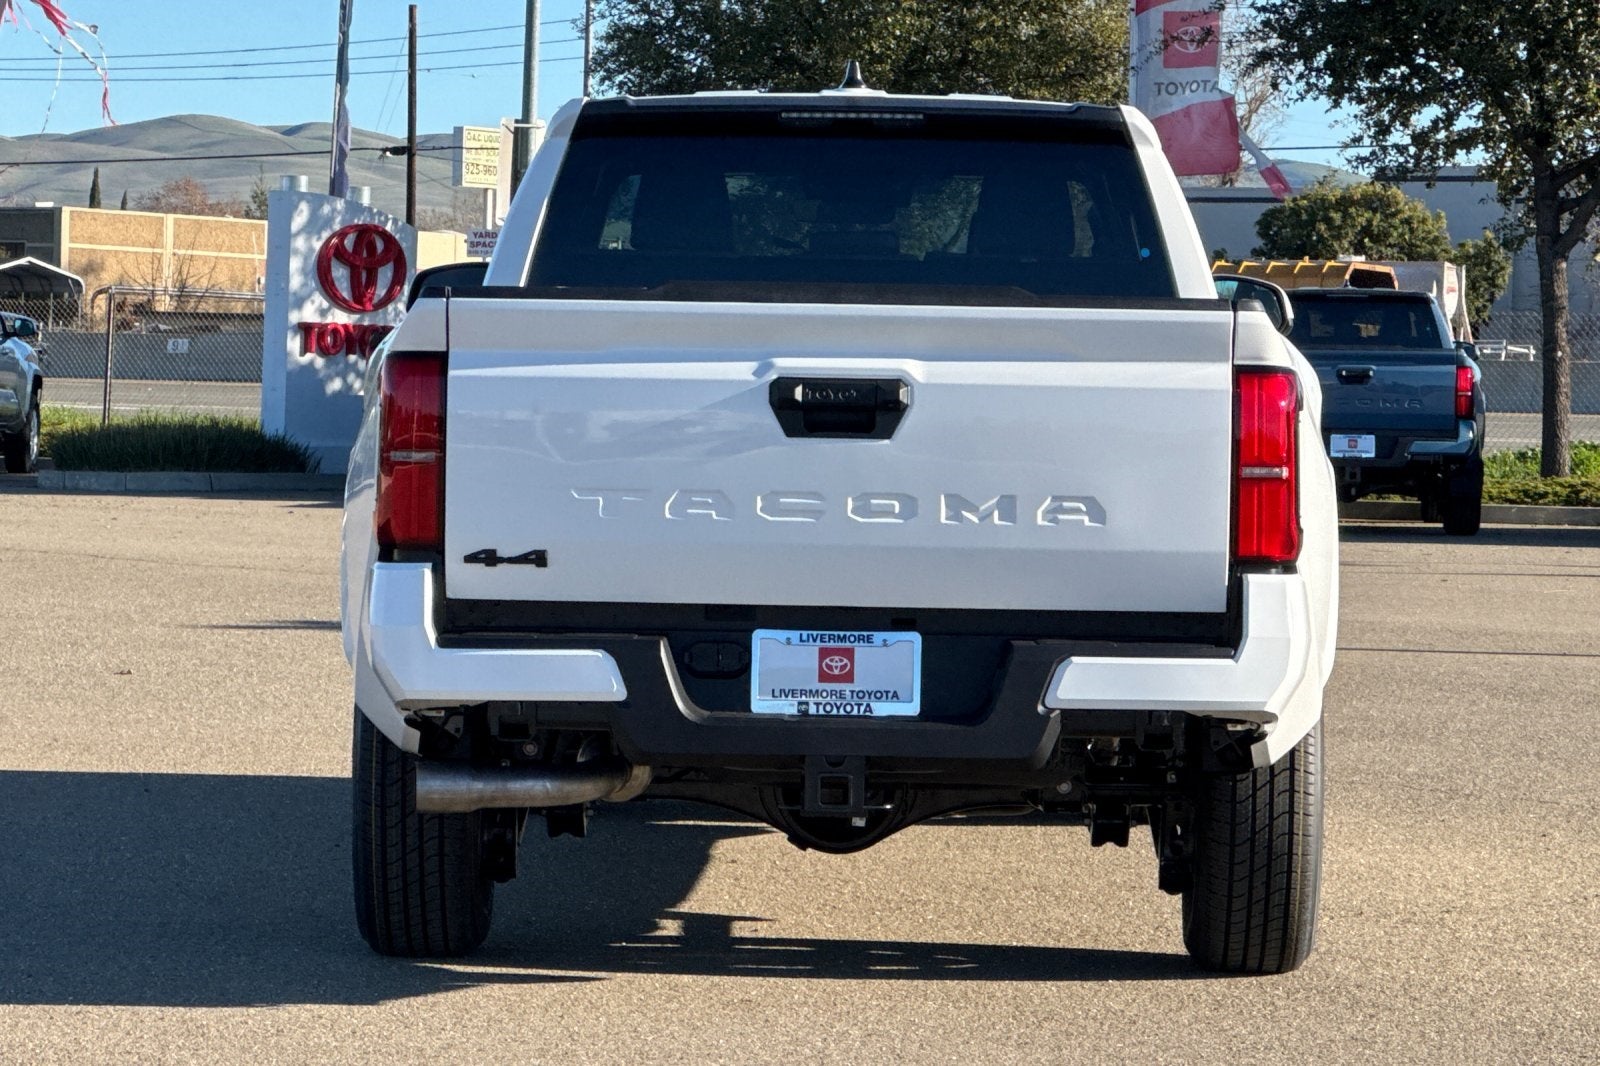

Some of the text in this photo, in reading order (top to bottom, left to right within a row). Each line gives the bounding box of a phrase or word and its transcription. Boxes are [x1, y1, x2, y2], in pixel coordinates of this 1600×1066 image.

[1154, 80, 1222, 96] TOYOTA
[472, 231, 498, 239] YARD
[571, 489, 1106, 527] TACOMA
[799, 633, 875, 645] LIVERMORE
[771, 688, 900, 701] LIVERMORE TOYOTA
[813, 702, 874, 715] TOYOTA
